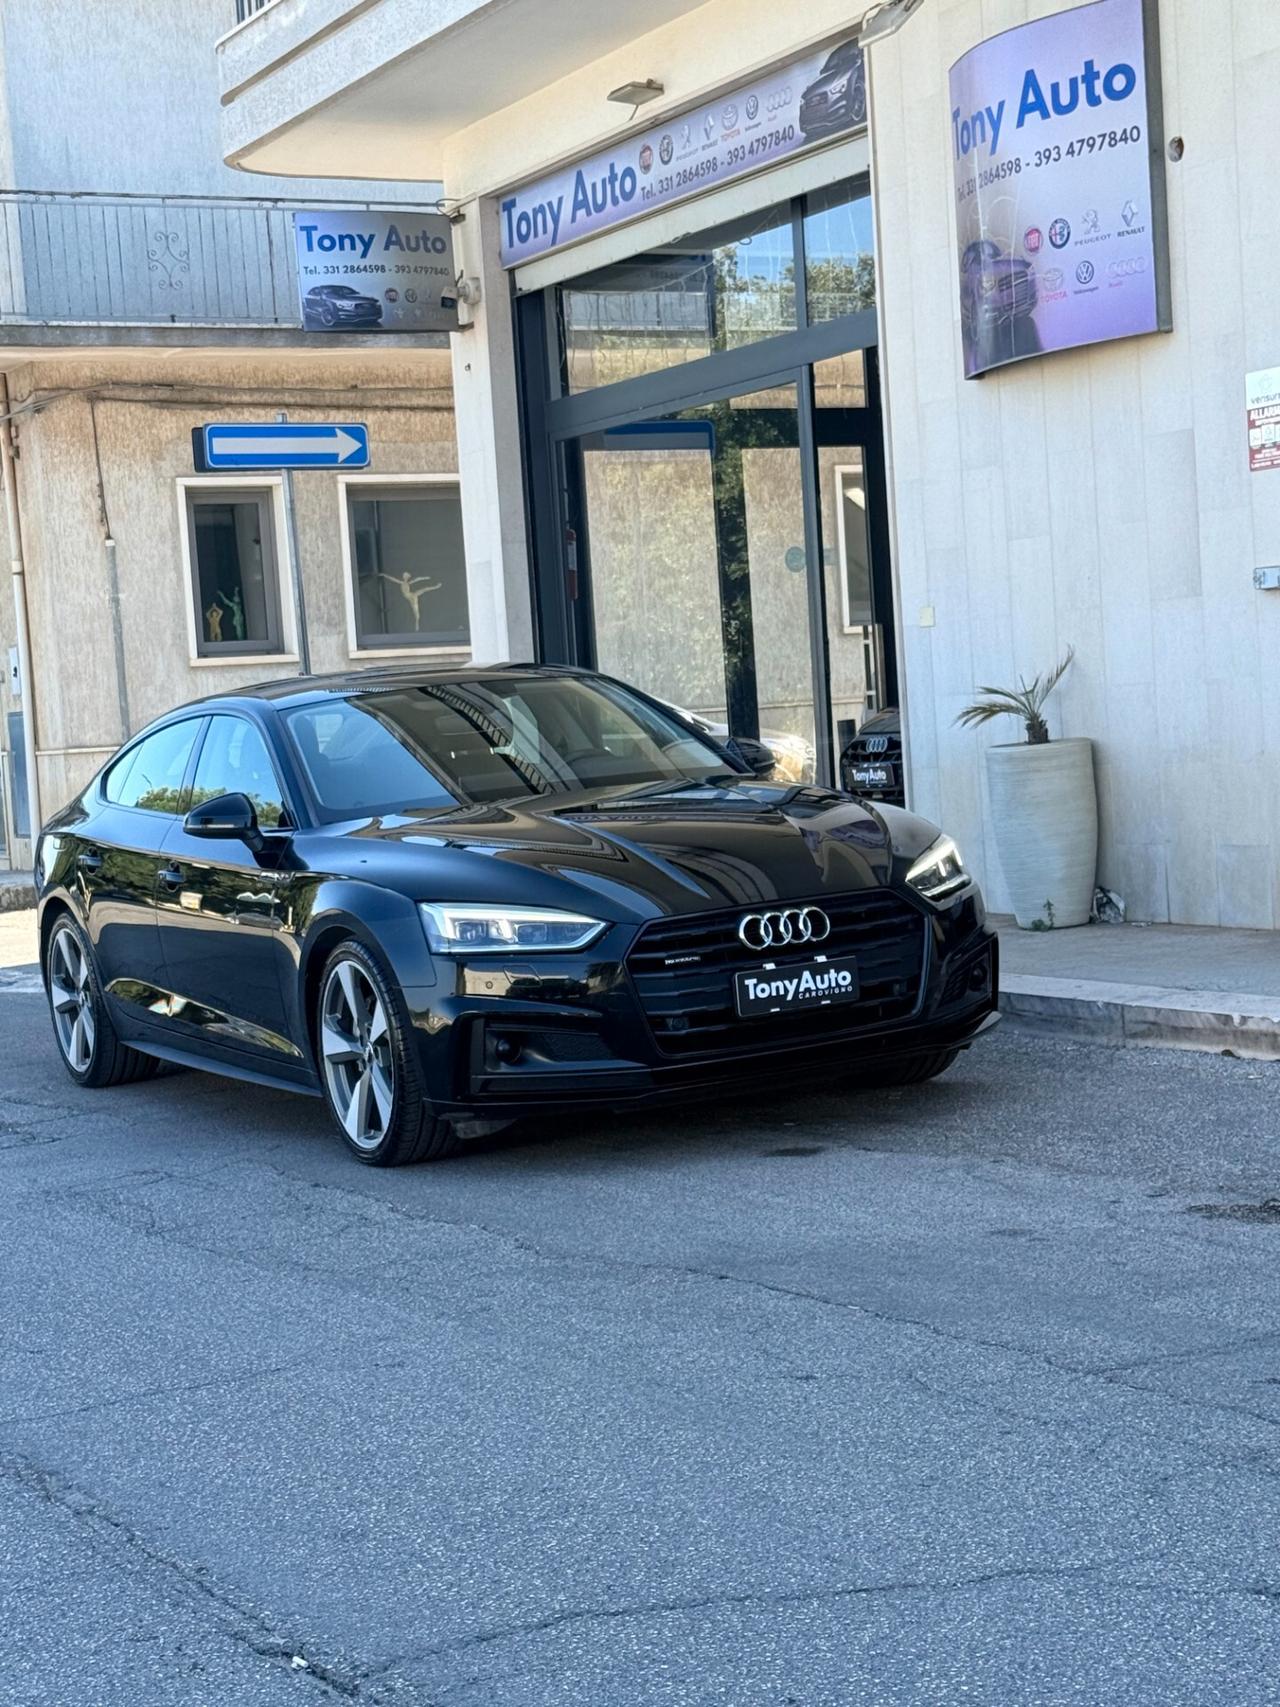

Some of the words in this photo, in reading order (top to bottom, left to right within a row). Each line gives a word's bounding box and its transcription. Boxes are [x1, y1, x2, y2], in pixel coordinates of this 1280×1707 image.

[952, 100, 1005, 160] Tony
[1016, 59, 1136, 129] Auto
[641, 186, 657, 201] Tel.
[658, 175, 673, 194] 331
[676, 156, 718, 188] 2864598
[727, 145, 746, 166] 393
[748, 124, 795, 156] 4797840
[978, 157, 1022, 190] 2864598
[1034, 145, 1061, 167] 393
[1065, 125, 1141, 158] 4797840
[502, 197, 564, 248] Tony
[571, 161, 637, 224] Auto
[300, 225, 375, 259] Tony
[384, 224, 447, 254] Auto
[1074, 233, 1112, 246] PEUGEOT
[1117, 226, 1146, 238] RENAULT
[303, 266, 321, 275] Tel.
[323, 265, 340, 274] 331
[343, 264, 386, 274] 2864598
[394, 265, 411, 274] 393
[413, 265, 450, 276] 4797840
[798, 985, 853, 999] CAROVIGNO
